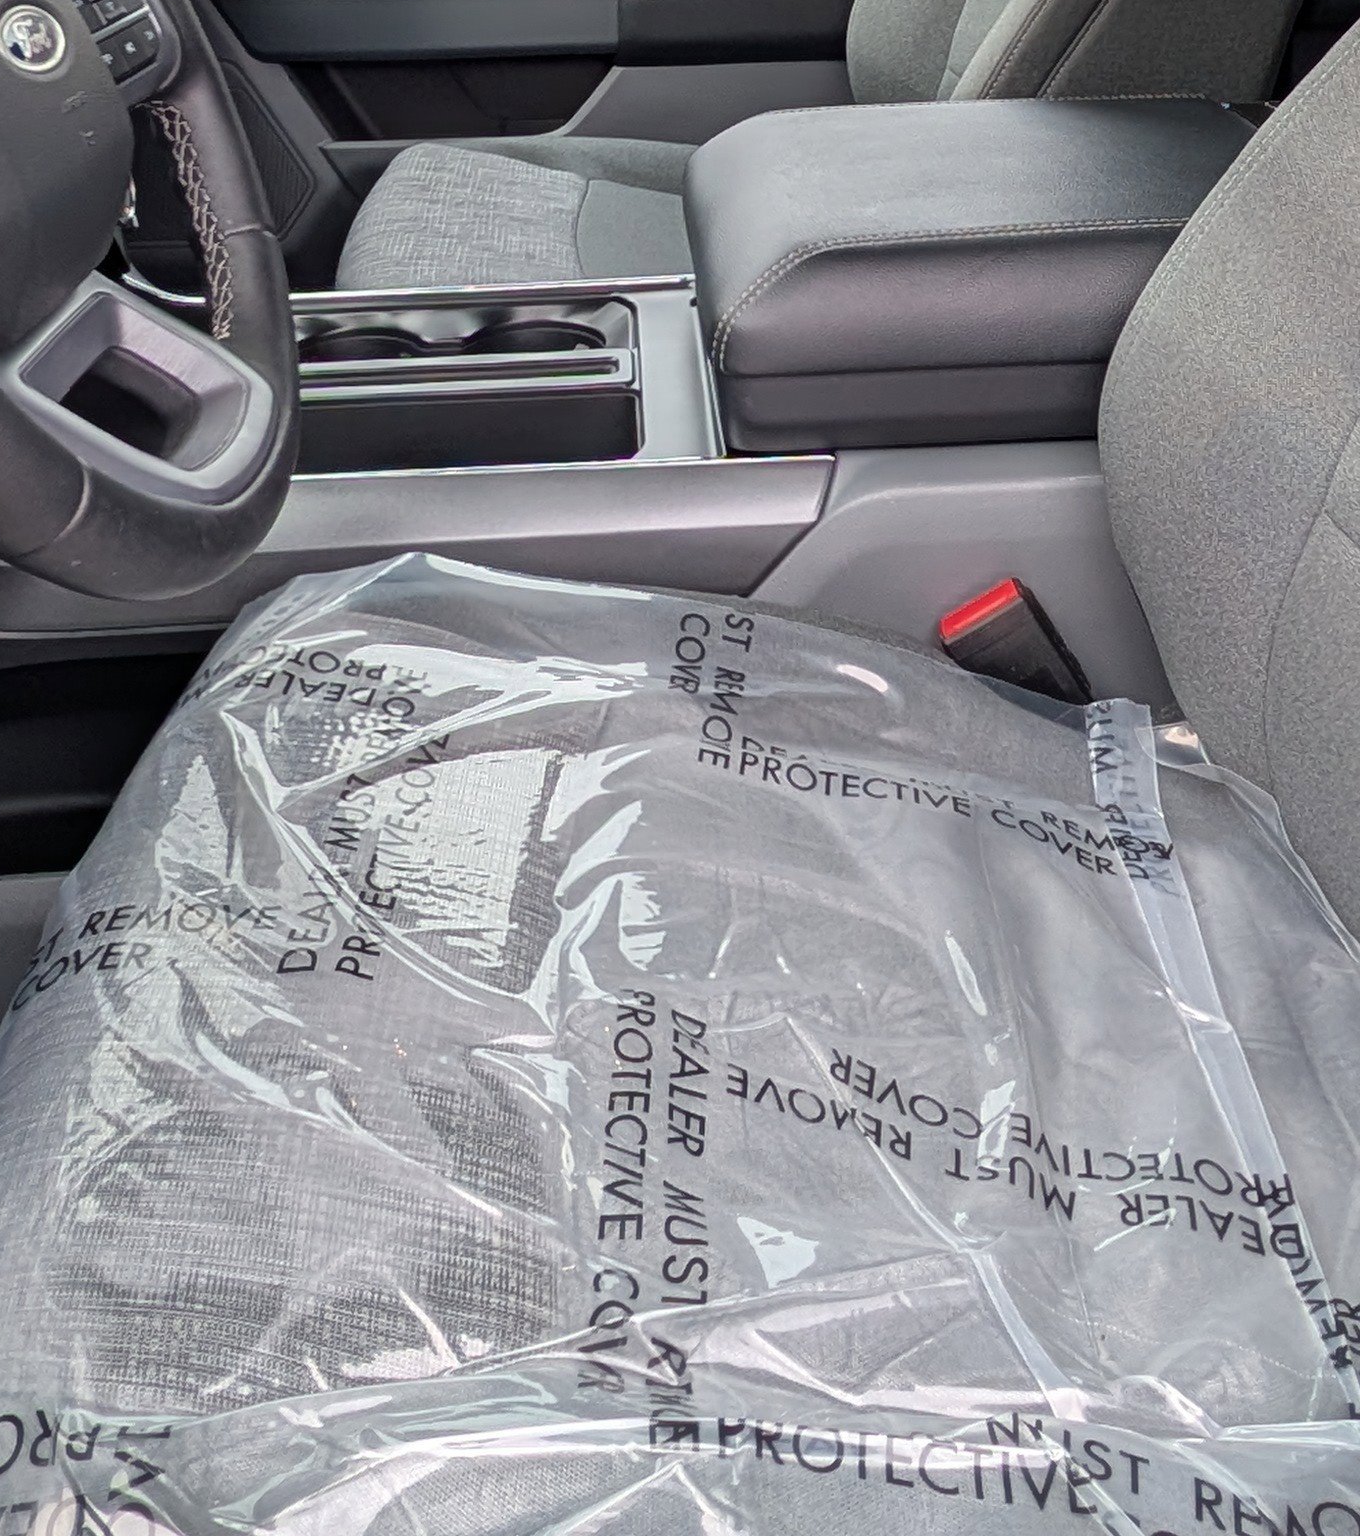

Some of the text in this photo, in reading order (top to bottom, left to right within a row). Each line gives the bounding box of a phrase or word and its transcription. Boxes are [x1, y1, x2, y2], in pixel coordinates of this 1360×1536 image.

[739, 752, 971, 818] PROTECTIVE
[991, 809, 1117, 876] COVER
[12, 942, 153, 1011] COVER
[598, 988, 656, 1240] PROTECTIVE
[667, 1009, 710, 1157] DEALER
[830, 1048, 984, 1140] COVER
[661, 1180, 708, 1305] MUST
[946, 1148, 1076, 1221] MUST
